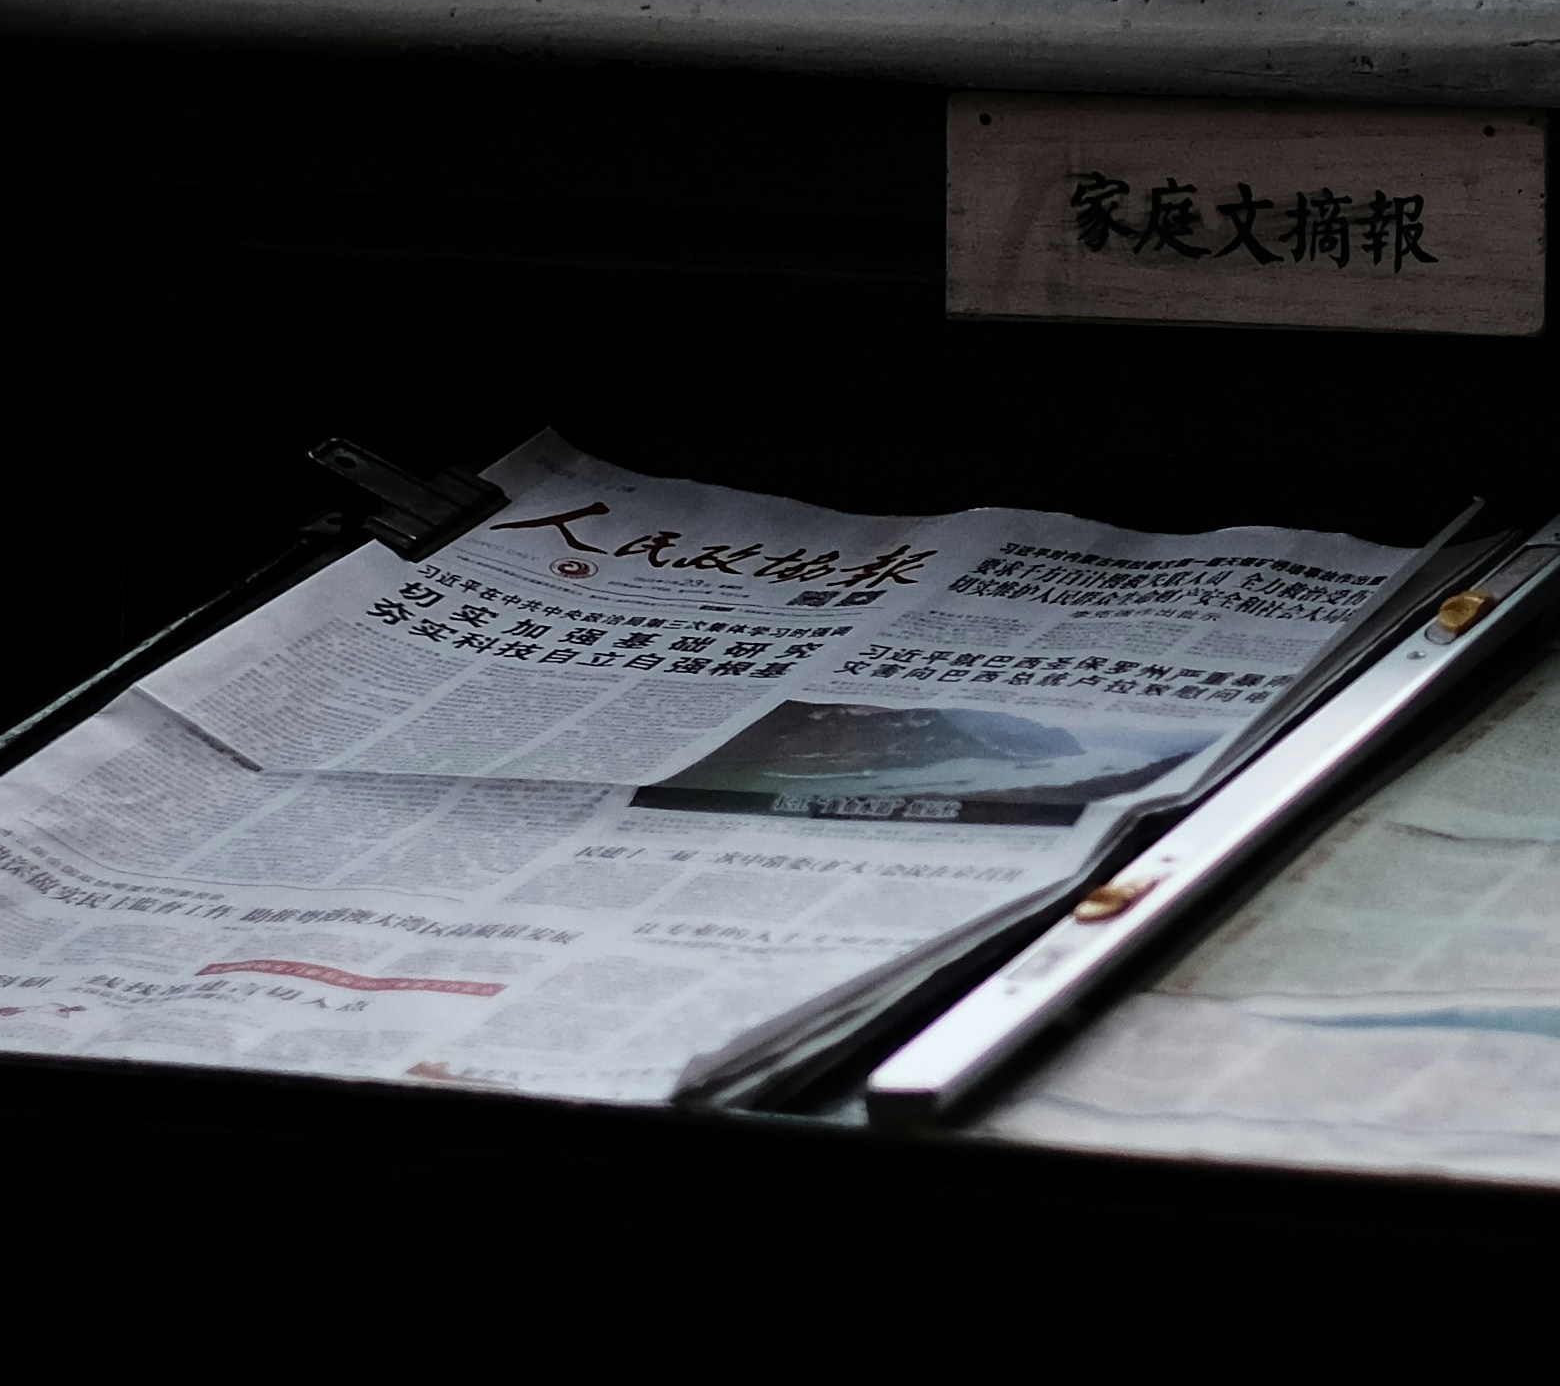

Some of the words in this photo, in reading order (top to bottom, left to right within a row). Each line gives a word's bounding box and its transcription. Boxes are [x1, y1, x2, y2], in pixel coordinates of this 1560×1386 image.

[1069, 170, 1441, 273] 家庭文摘報
[365, 597, 799, 680] 夯实科技自立自强根基
